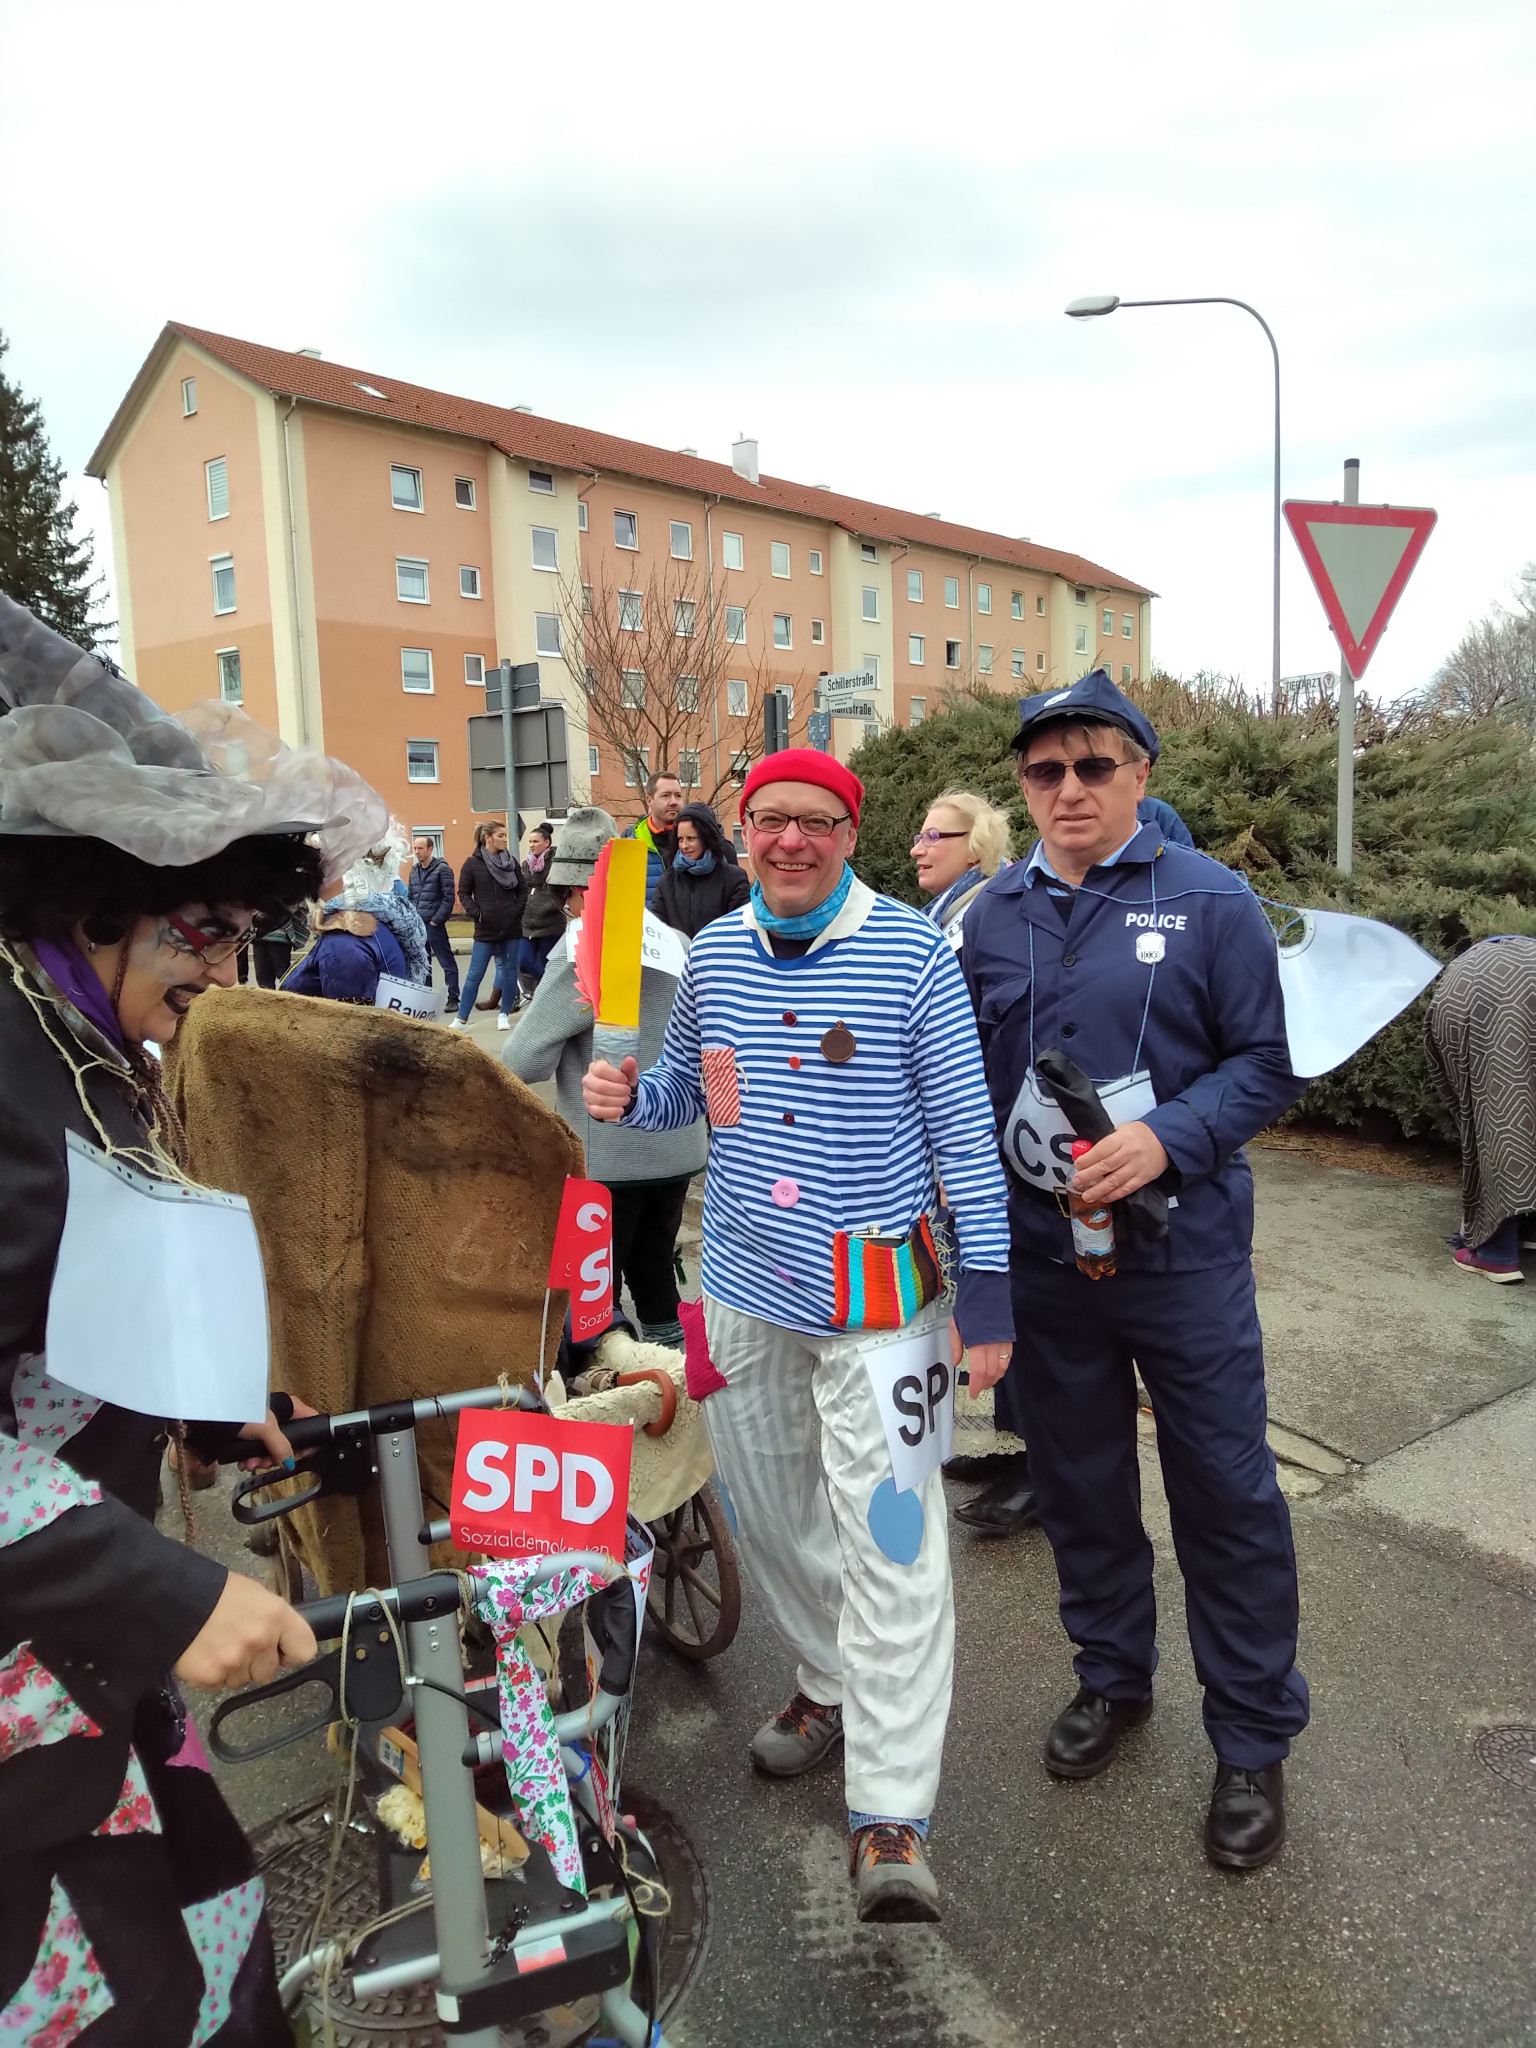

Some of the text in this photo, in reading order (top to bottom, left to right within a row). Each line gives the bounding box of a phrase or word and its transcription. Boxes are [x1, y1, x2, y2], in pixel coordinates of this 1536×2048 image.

[827, 673, 874, 691] Schillerstraße
[1285, 678, 1321, 691] TIERARZT
[1125, 912, 1187, 930] POLICE
[579, 1241, 613, 1302] S
[892, 1362, 953, 1447] SP
[462, 1440, 615, 1525] SPD
[460, 1526, 611, 1554] Sozialdemoken
